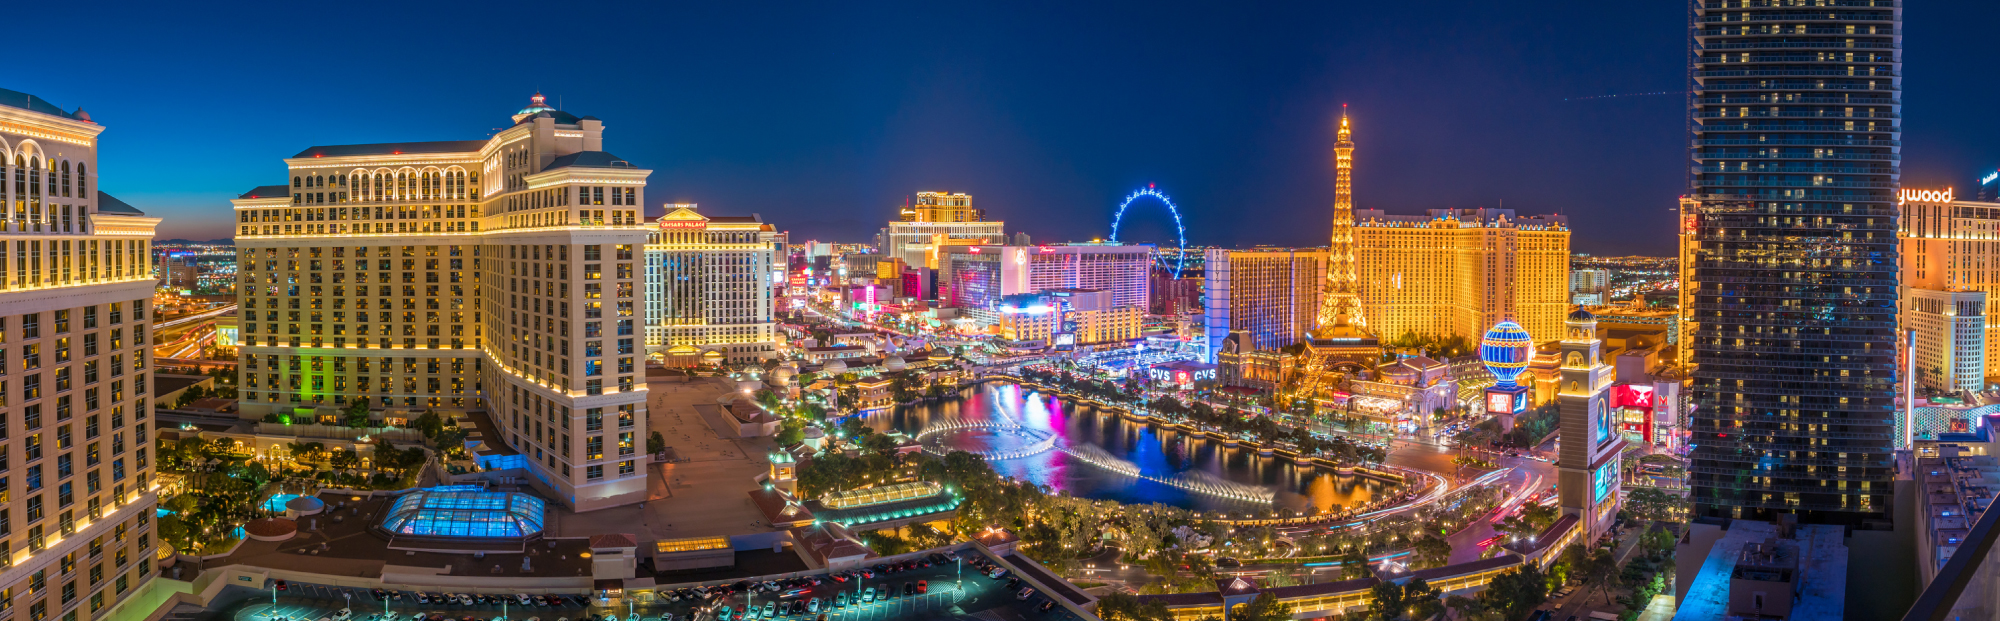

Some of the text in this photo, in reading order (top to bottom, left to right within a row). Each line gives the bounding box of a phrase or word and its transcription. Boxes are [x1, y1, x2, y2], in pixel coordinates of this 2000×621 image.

[1150, 368, 1171, 381] CVS
[1194, 369, 1216, 381] CVS
[1951, 421, 1966, 431] KOI
